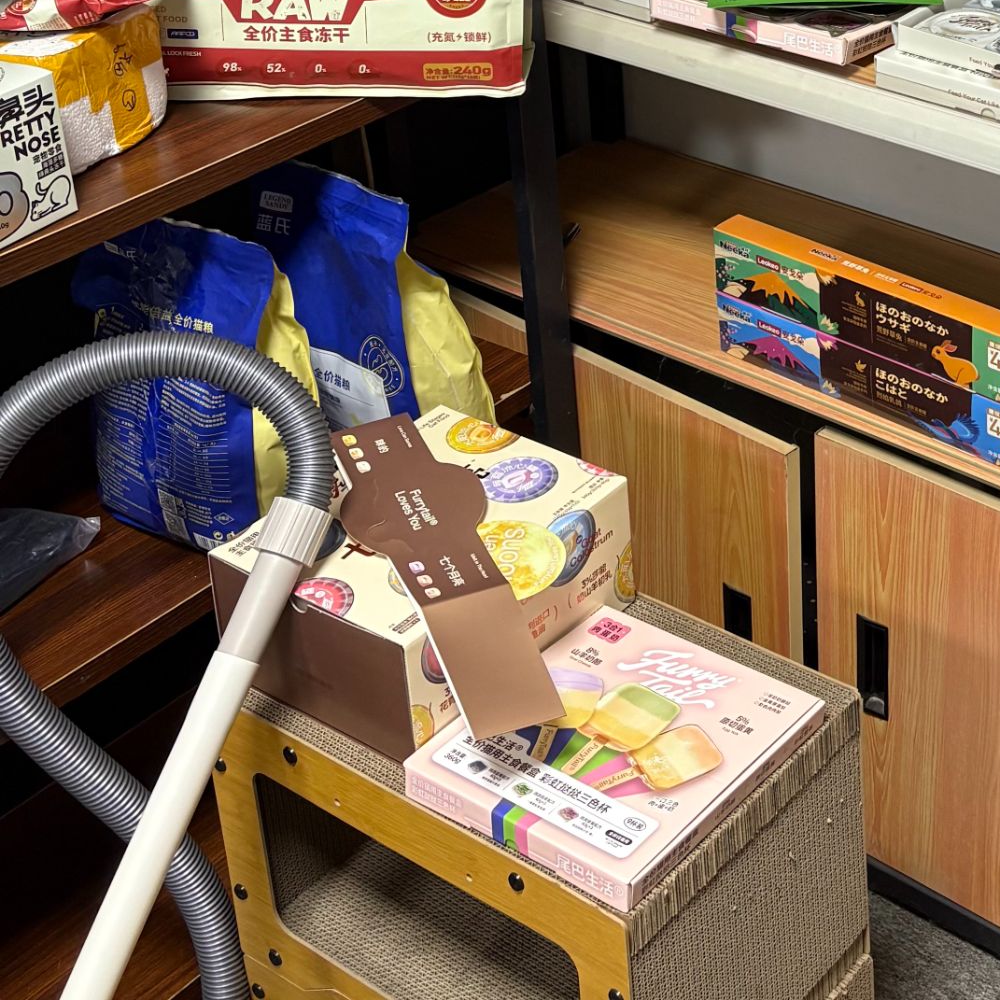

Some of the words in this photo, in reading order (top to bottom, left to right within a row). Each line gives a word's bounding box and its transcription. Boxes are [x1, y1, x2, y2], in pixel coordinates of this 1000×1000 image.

[244, 26, 349, 42] 全价主食冻干
[15, 126, 60, 162] NOSE
[256, 214, 291, 236] 蓝氏
[174, 313, 213, 334] 全价猫粮
[876, 301, 949, 336] ほのおのなか
[876, 314, 911, 333] ウサギ
[314, 367, 351, 391] 全价猫粮
[876, 368, 948, 403] ほのおのなか
[395, 491, 414, 516] Loves
[410, 516, 422, 531] You
[603, 621, 622, 633] 3合1
[617, 649, 736, 690] Furry
[639, 670, 715, 709] Tail
